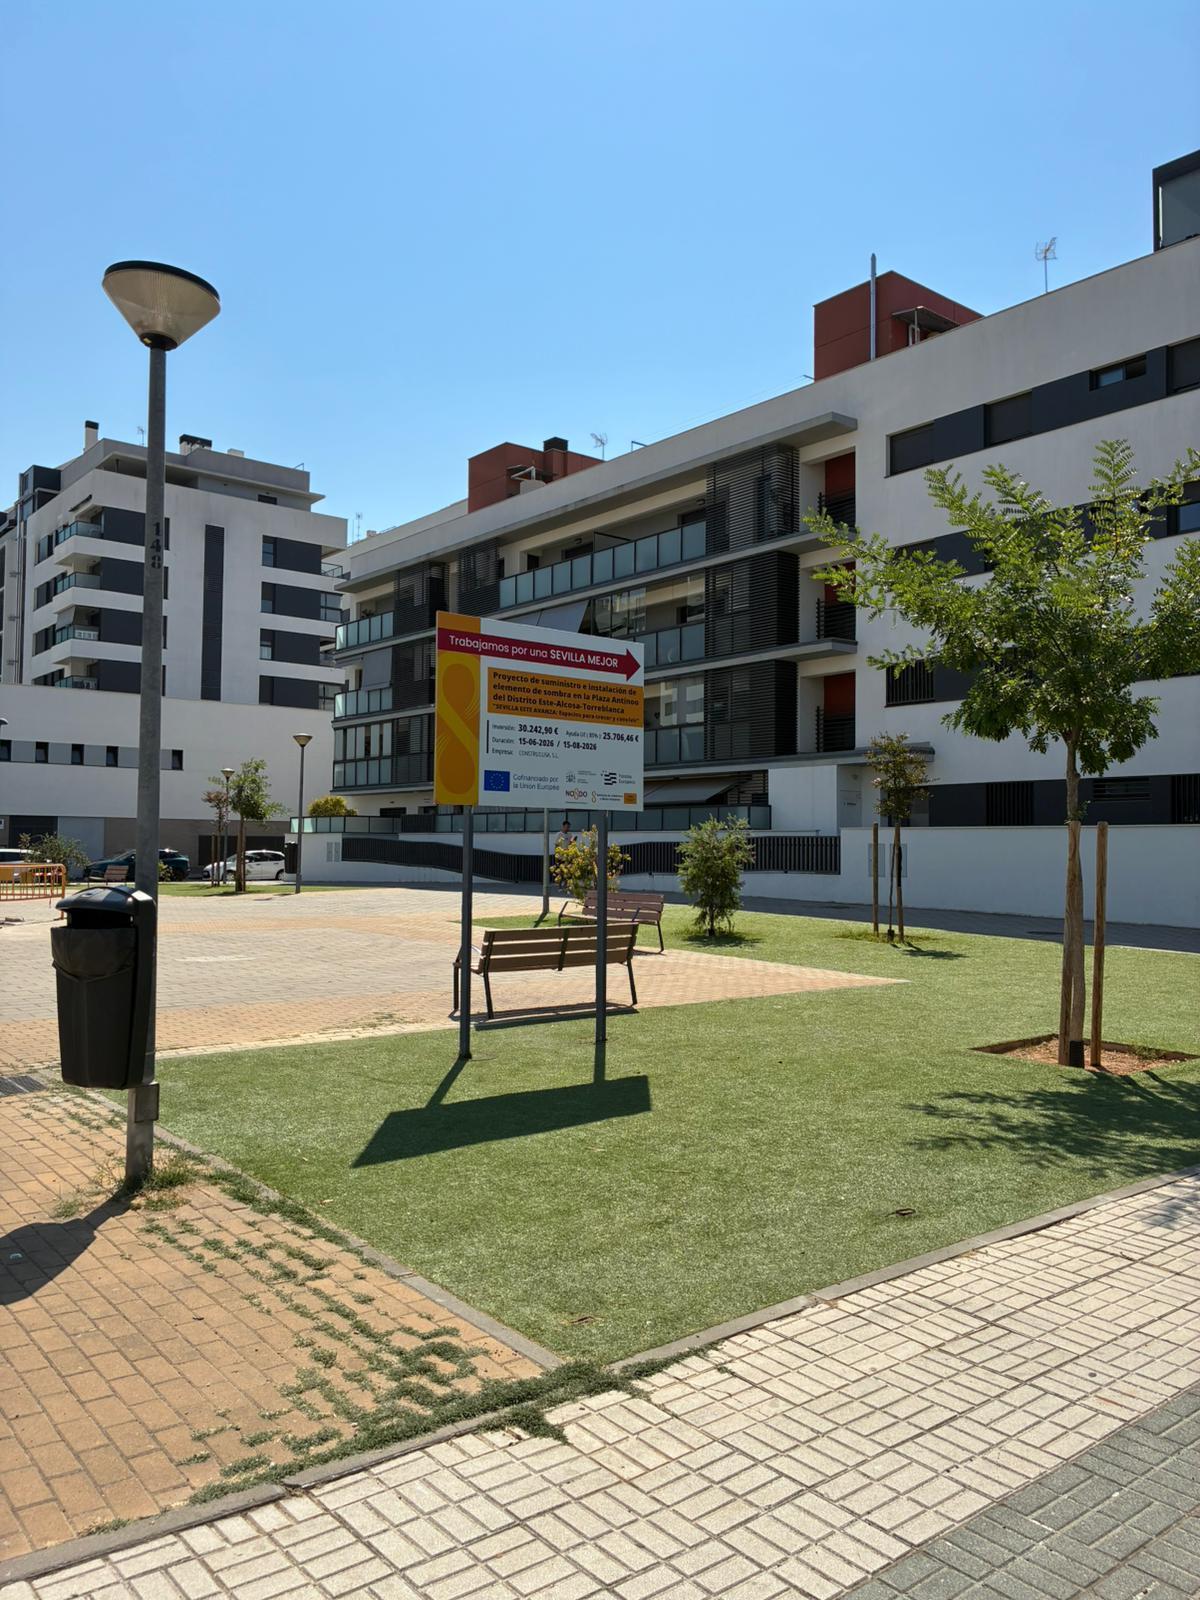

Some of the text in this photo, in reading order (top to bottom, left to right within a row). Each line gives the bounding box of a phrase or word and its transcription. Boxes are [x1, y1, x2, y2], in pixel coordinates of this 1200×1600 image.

[150, 522, 161, 569] 148
[449, 635, 618, 668] Trabajamos por una SEVILLA MEJOR
[493, 672, 528, 682] Proyecto
[542, 678, 580, 689] suministro
[589, 683, 626, 694] instalación
[493, 683, 530, 694] elemento
[544, 689, 572, 698] sombra
[584, 692, 590, 700] la
[592, 694, 610, 702] Plaza
[493, 693, 624, 714] del Distrito Este-Alcosa-Torreblanca
[518, 724, 552, 735] 30.242,90
[554, 727, 558, 735] €
[603, 732, 634, 742] 25.706,46
[519, 738, 554, 747] 15-06-2026
[564, 741, 597, 750] 15-08-2026
